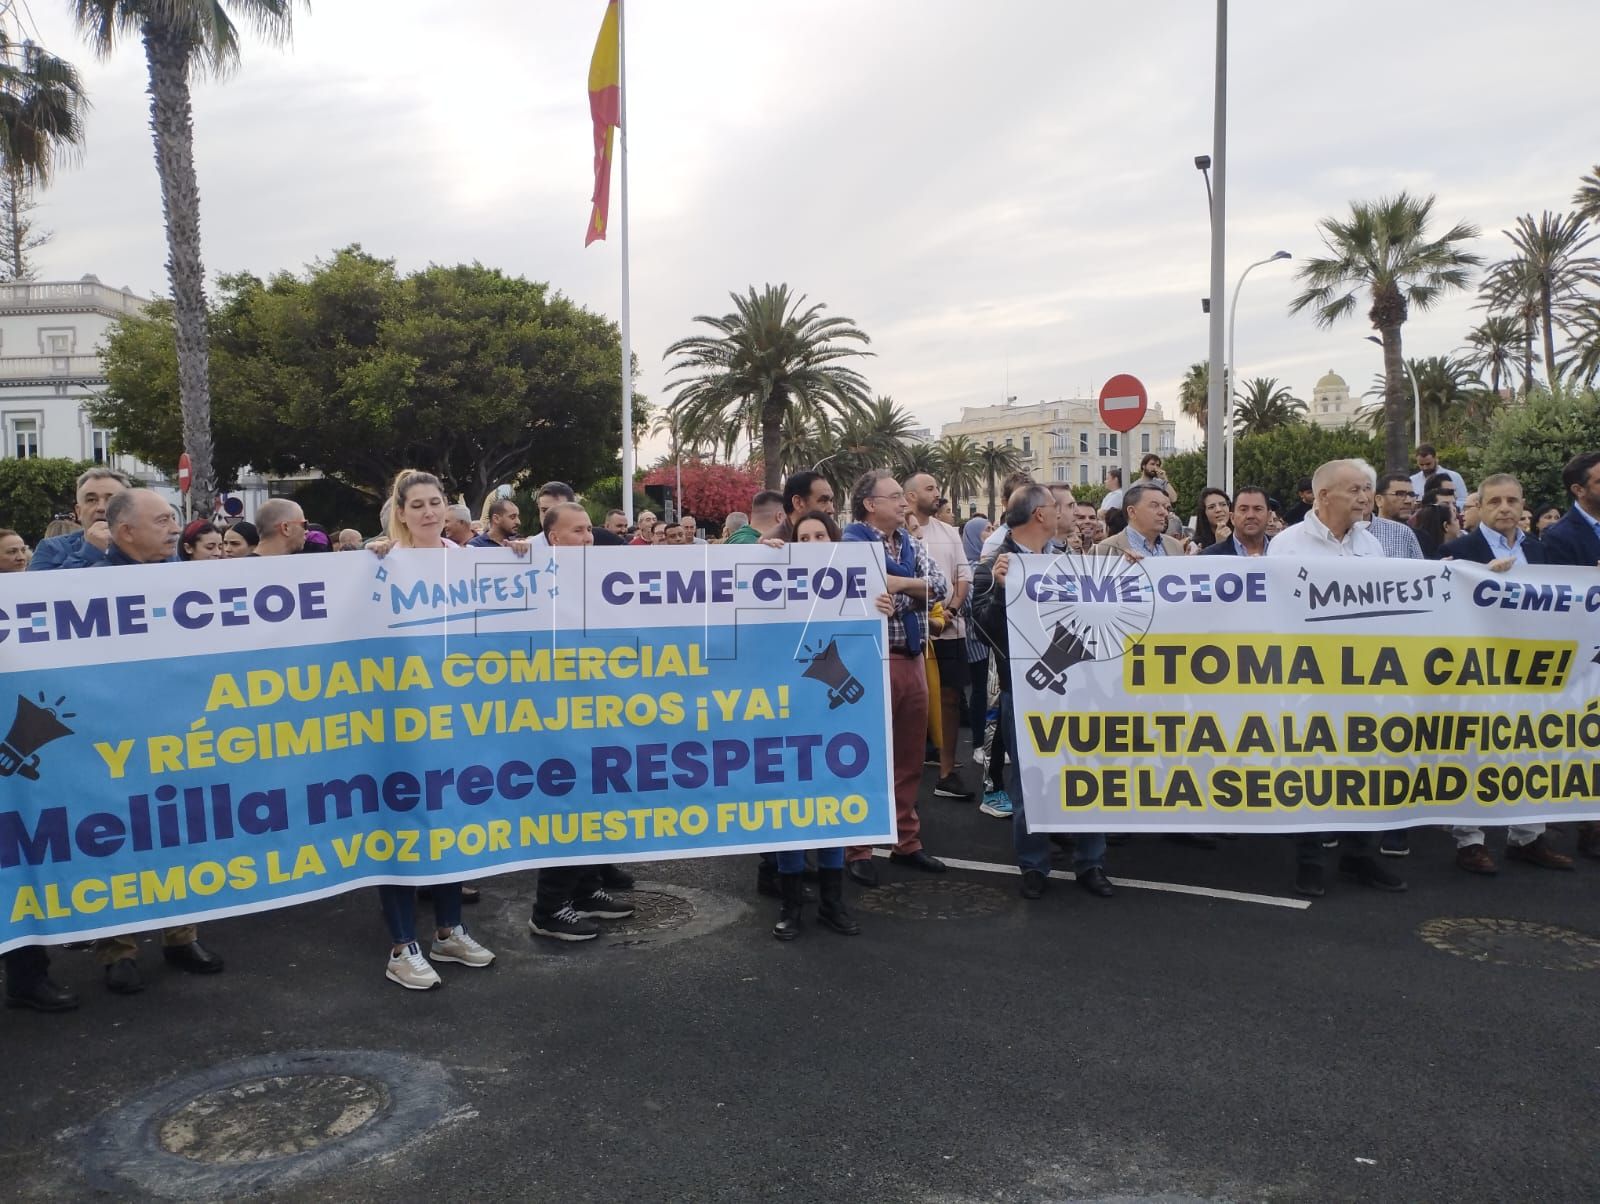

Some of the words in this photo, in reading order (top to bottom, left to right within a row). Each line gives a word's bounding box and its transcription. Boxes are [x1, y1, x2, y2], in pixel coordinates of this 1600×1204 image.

[0, 581, 328, 644] EME-CEOE
[391, 569, 538, 614] MANIFEST
[1308, 575, 1436, 609] MANIFEST
[205, 656, 434, 712] ADUANA
[441, 643, 709, 687] COMERCIAL
[1132, 645, 1325, 686] ¡TOMA
[1341, 647, 1408, 686] LA
[1424, 647, 1572, 686] CALLE!
[94, 739, 134, 779] Y
[148, 708, 385, 775] RÉGIMEN
[394, 704, 453, 743] DE
[460, 691, 686, 740] VIAJEROS
[696, 685, 791, 731] ¡YA!
[1028, 715, 1228, 752] VUELTA
[1237, 716, 1276, 752] A
[1284, 715, 1336, 752] LA
[0, 784, 289, 869] Melilla
[306, 758, 577, 825] merece
[591, 732, 869, 795] RESPETO
[1065, 770, 1127, 807] DE
[1139, 769, 1204, 806] LA
[1212, 766, 1467, 807] SEGURIDAD
[10, 855, 258, 922] ALCEMOS
[267, 844, 326, 883] LA
[332, 830, 421, 868] VOZ
[431, 821, 512, 861] POR
[520, 805, 708, 847] NUESTRO
[717, 795, 869, 832] FUTURO
